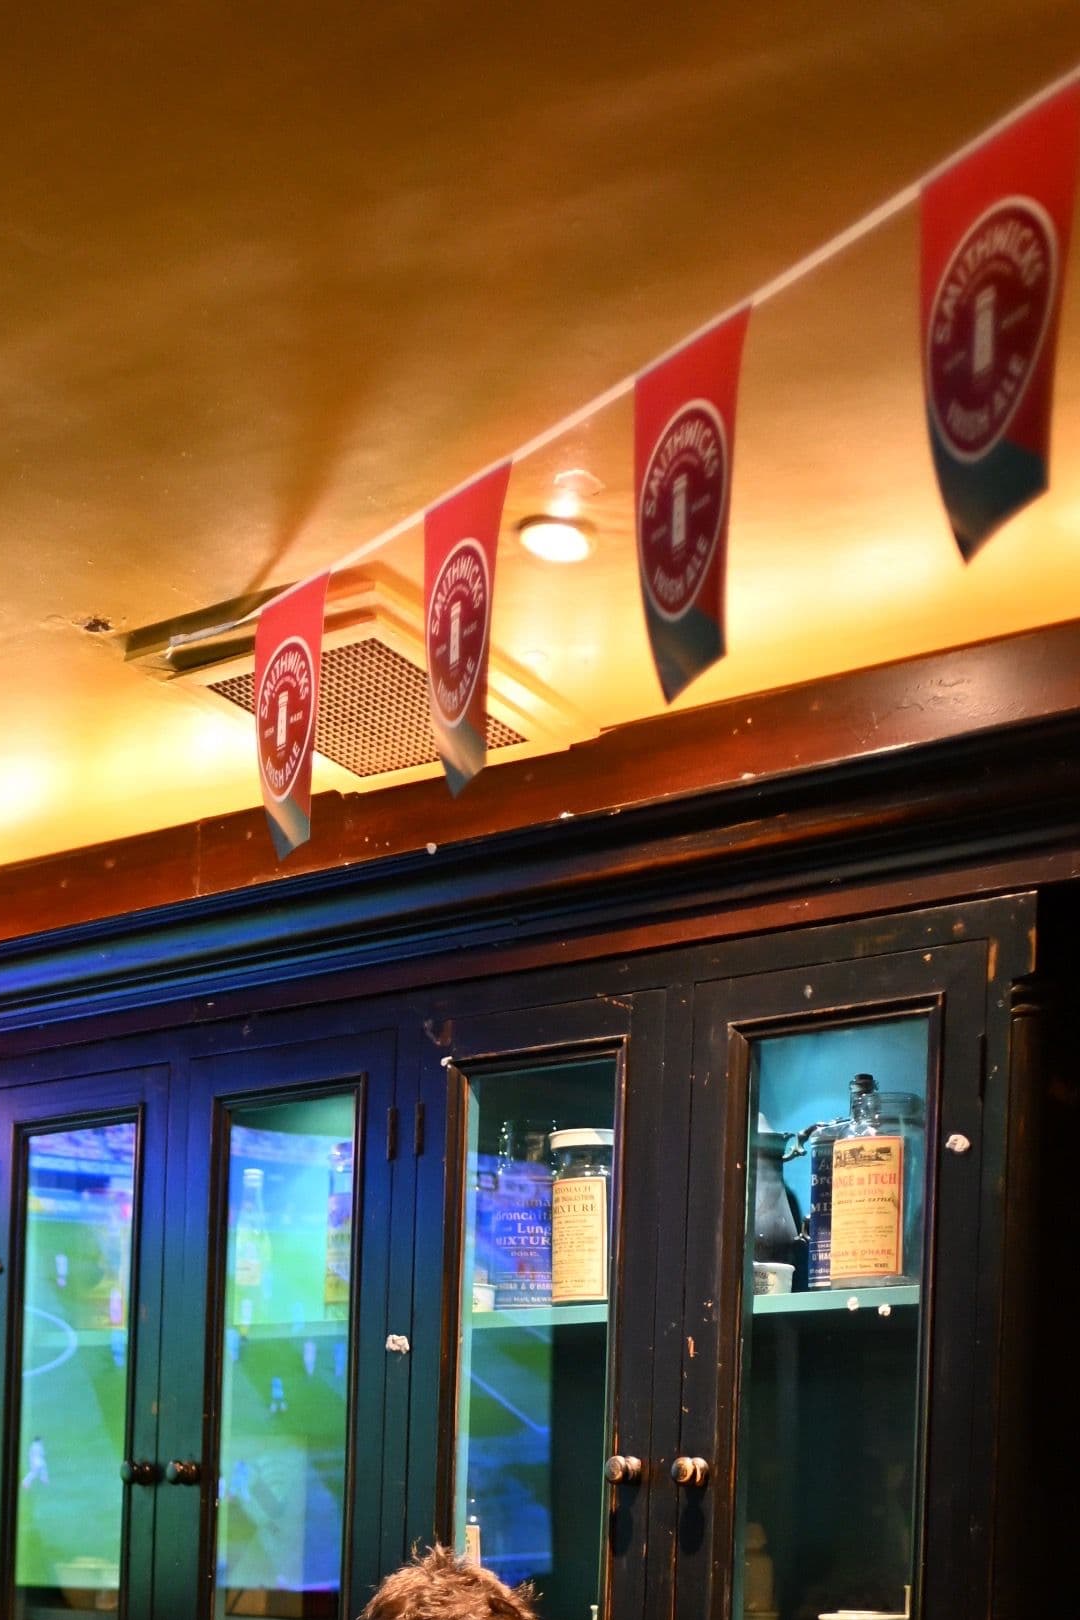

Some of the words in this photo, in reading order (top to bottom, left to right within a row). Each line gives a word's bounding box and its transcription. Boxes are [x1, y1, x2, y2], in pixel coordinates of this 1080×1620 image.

[265, 755, 284, 789] IRISH
[285, 741, 301, 783] ALE
[517, 1222, 552, 1237] Lung
